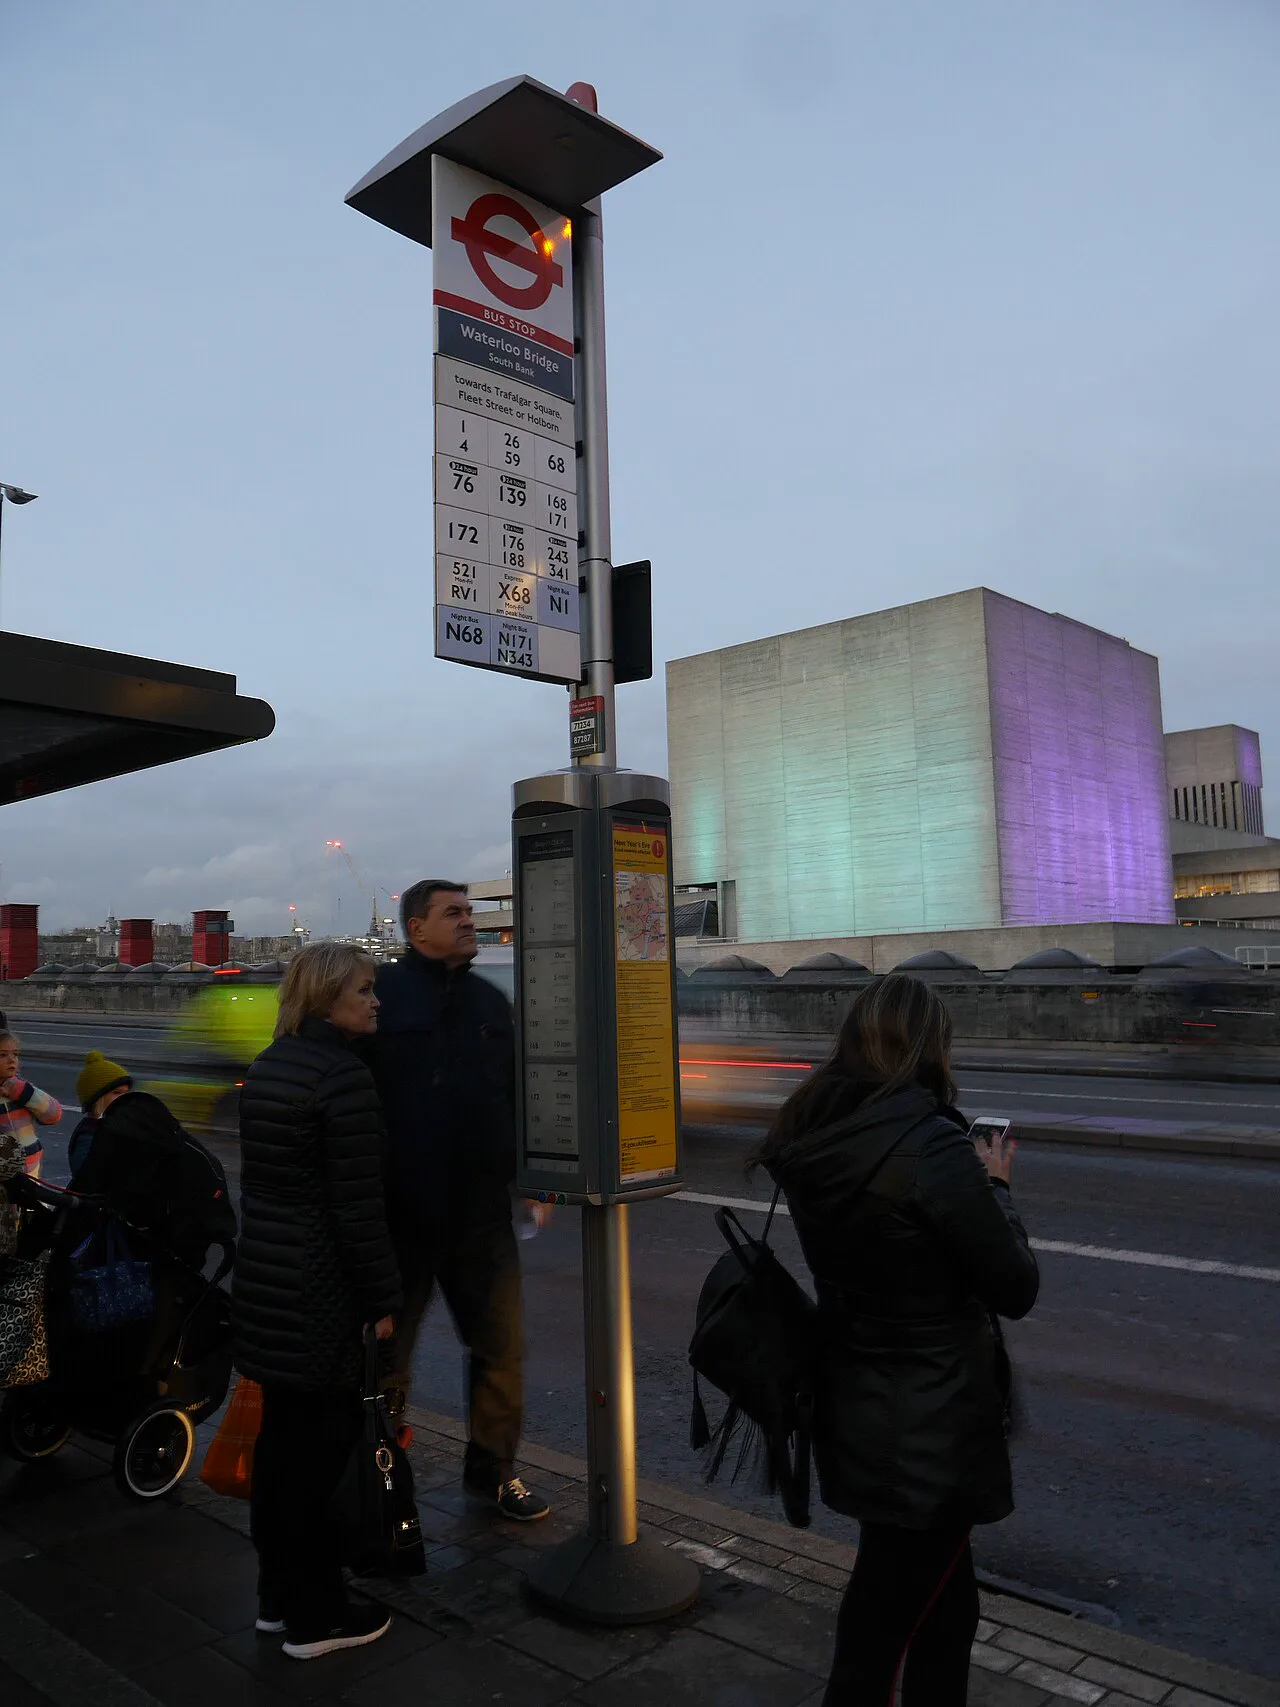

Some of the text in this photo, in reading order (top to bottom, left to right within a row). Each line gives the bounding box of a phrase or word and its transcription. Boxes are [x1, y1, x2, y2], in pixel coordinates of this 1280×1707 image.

[484, 310, 536, 337] BUS STOP
[460, 324, 559, 373] Waterloo Bridge
[489, 353, 535, 378] South Bank
[454, 374, 492, 393] towards
[494, 386, 532, 407] Trafalgar
[458, 391, 560, 432] Fleet Street or Holborn
[461, 420, 465, 433] 1
[459, 440, 468, 452] 4
[504, 433, 520, 449] 26
[504, 451, 520, 466] 59
[548, 455, 565, 473] 68
[464, 466, 477, 474] hour
[453, 473, 474, 493] 76
[500, 486, 526, 506] 139
[548, 494, 567, 511] 168
[549, 512, 567, 529] 171
[449, 522, 478, 544] 172
[503, 534, 524, 551] 176
[504, 551, 524, 567] 188
[548, 547, 568, 564] 243
[452, 562, 476, 578] 521
[504, 574, 524, 583] Express
[549, 563, 568, 580] 341
[451, 585, 476, 602] RV1
[498, 582, 531, 604] X68
[548, 585, 561, 594] Night
[504, 602, 525, 611] Mon-Fri
[550, 595, 568, 614] N1
[451, 613, 478, 624] Night Bus
[505, 609, 518, 617] peak
[518, 611, 533, 620] hours
[446, 622, 483, 645] N68
[502, 623, 517, 632] Night
[499, 632, 532, 650] N171
[498, 648, 532, 667] N343
[574, 734, 591, 744] 87287
